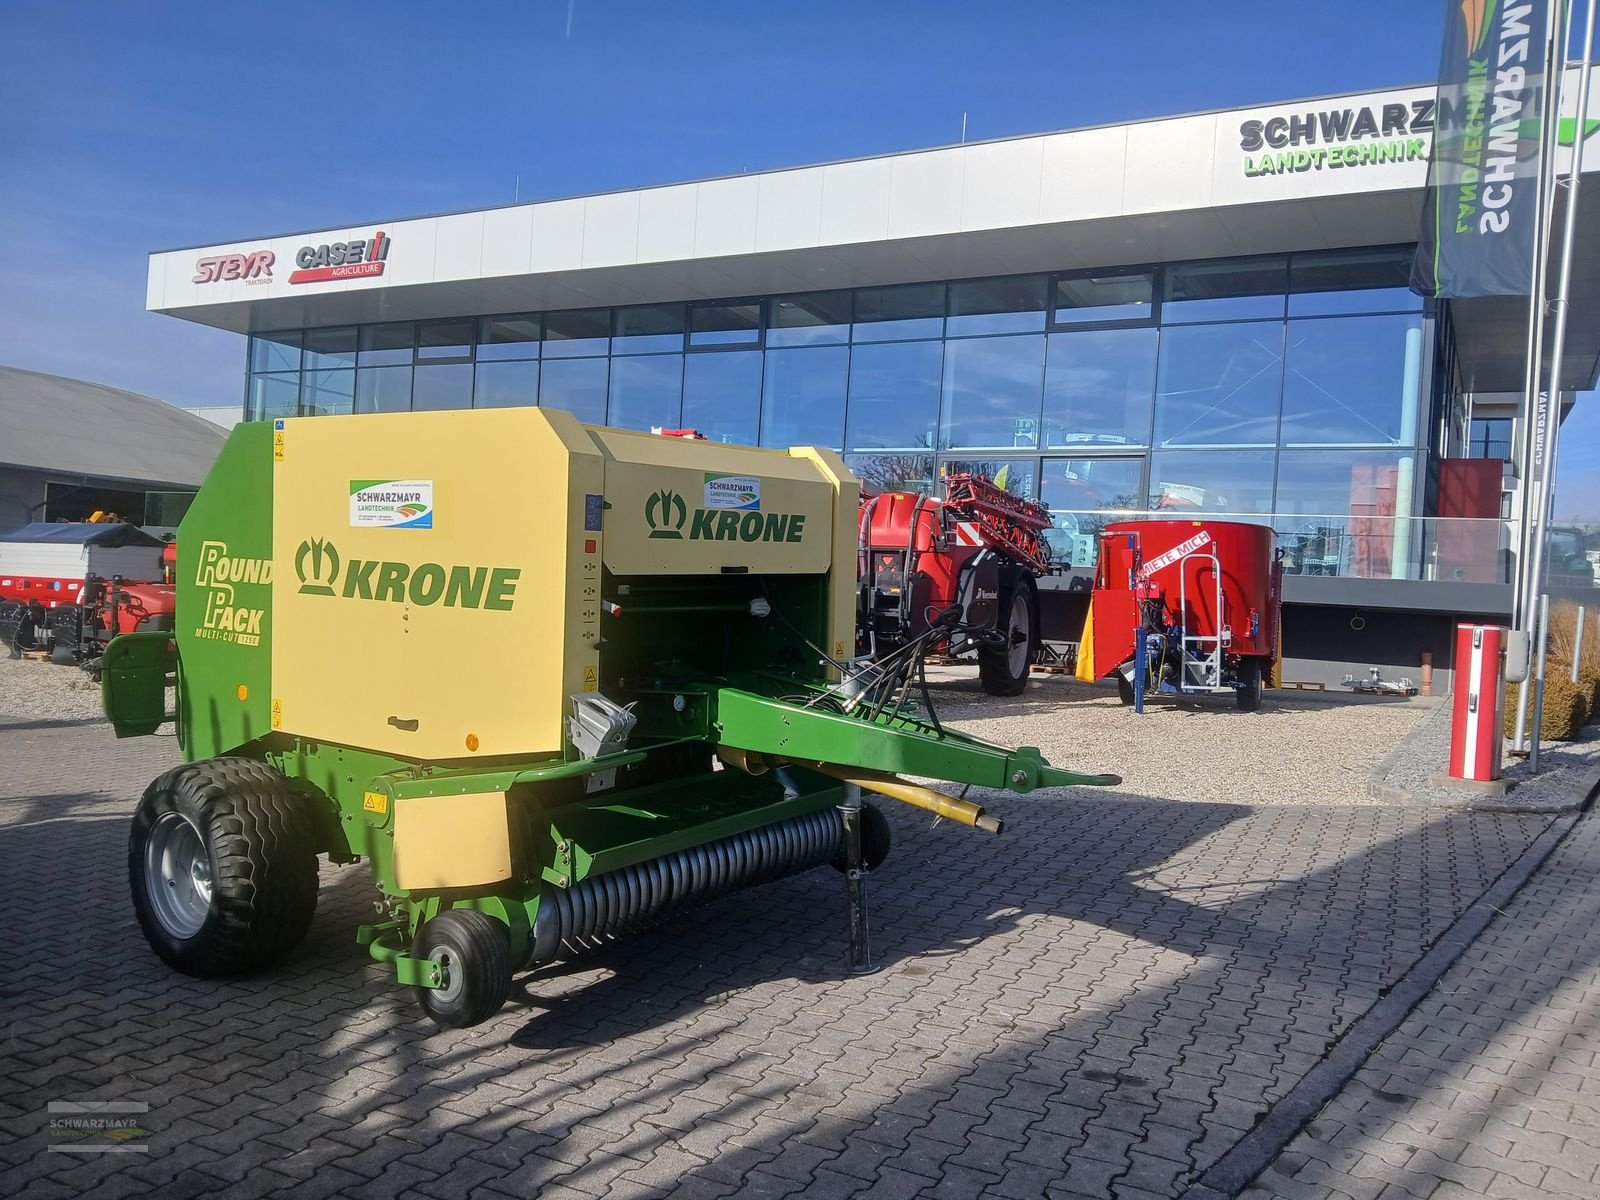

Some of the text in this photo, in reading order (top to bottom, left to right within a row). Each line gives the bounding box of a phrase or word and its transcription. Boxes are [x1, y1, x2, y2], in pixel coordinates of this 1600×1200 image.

[1244, 138, 1430, 177] LANDTECHNIK
[192, 250, 276, 284] STEYR
[296, 240, 366, 269] CASE
[245, 278, 274, 287] TRAKTOREN
[331, 264, 379, 277] AGRICULTURE
[356, 492, 421, 503] SCHWARZMAYR
[709, 482, 754, 492] SCHWARZMAYR
[357, 504, 395, 512] LANDTECHNIK
[689, 509, 806, 543] KRONE
[1175, 531, 1211, 557] MICH
[195, 540, 273, 587] ROUND
[342, 559, 521, 611] KRONE
[203, 583, 264, 635] PACK
[194, 627, 258, 645] MULTI-CUT 1250
